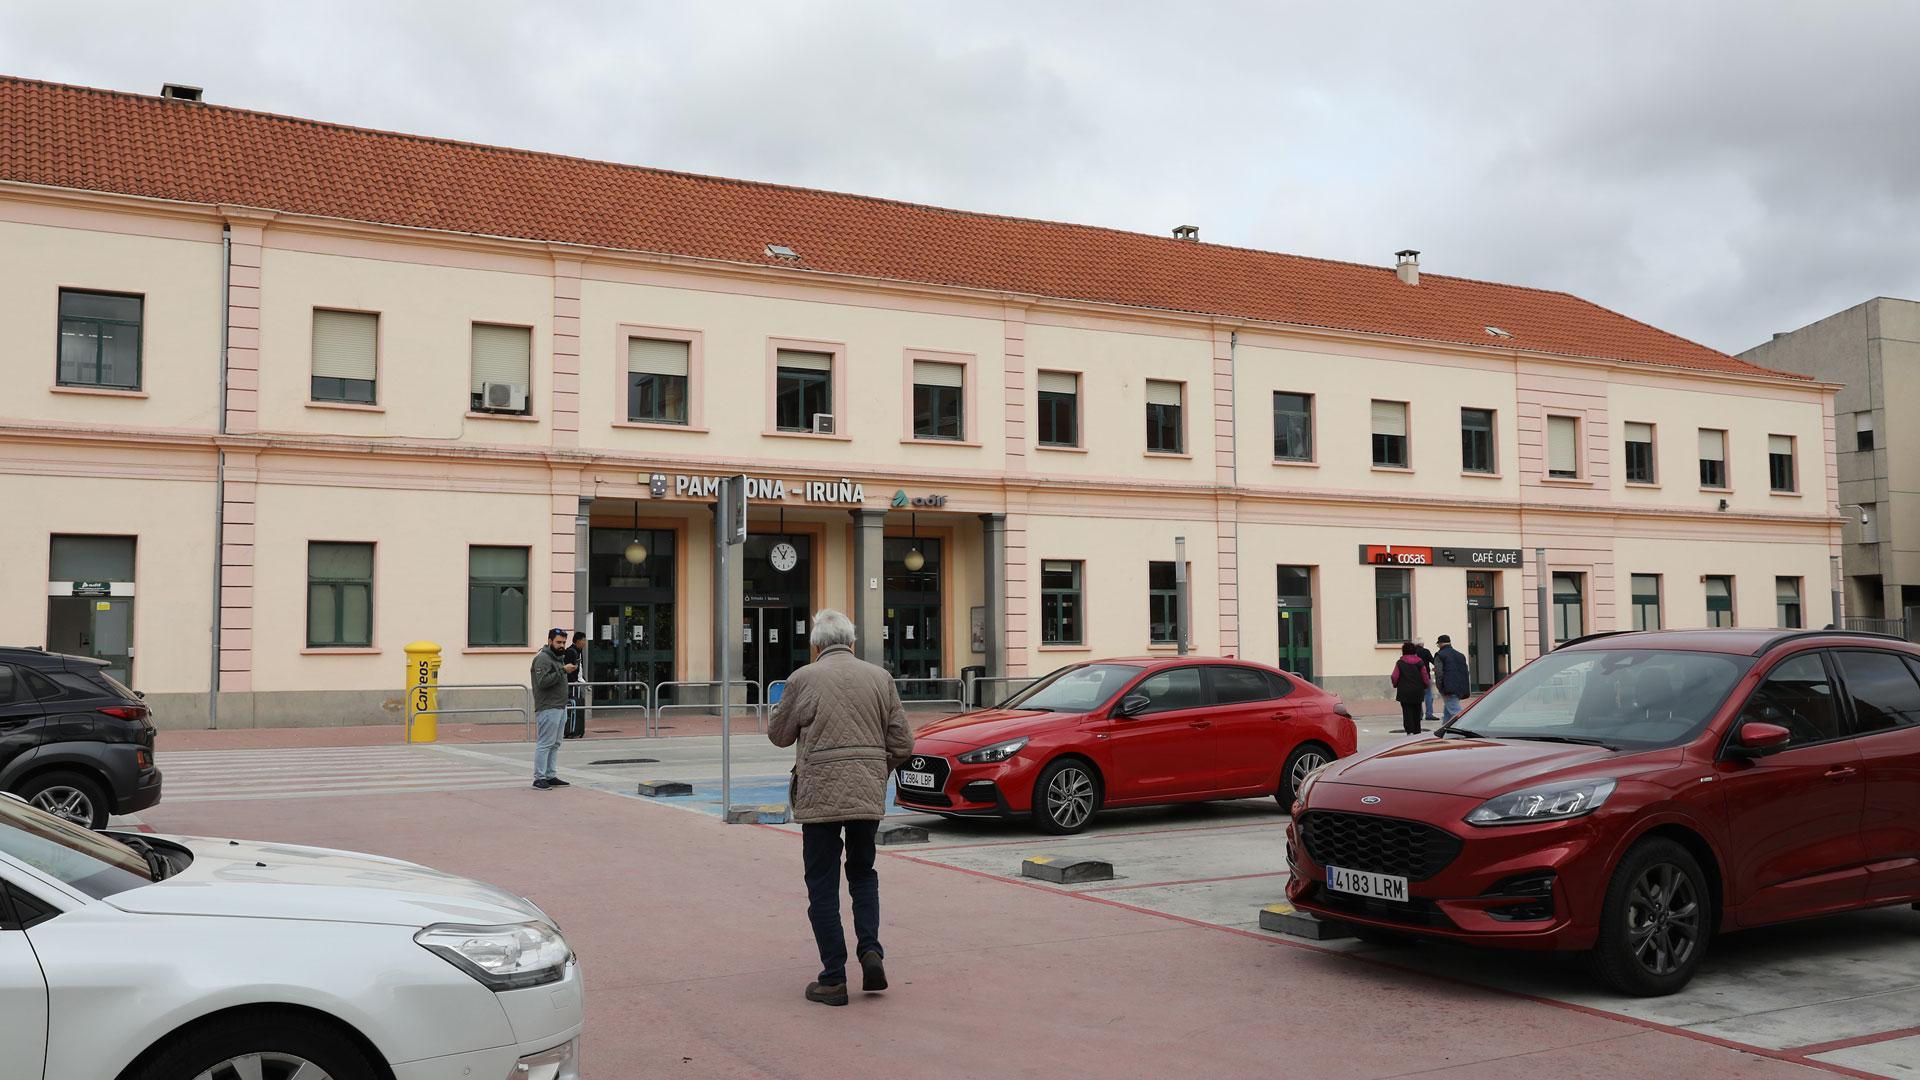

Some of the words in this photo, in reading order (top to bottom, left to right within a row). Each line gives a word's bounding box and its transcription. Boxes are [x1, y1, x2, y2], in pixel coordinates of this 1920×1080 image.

[675, 475, 785, 500] PAMONA
[806, 478, 865, 504] IRUÑA
[1472, 550, 1494, 563] CAFÉ
[1496, 551, 1517, 564] CAFÉ
[922, 776, 932, 785] LBP
[1335, 871, 1369, 893] 4183
[1374, 877, 1403, 899] LRM
